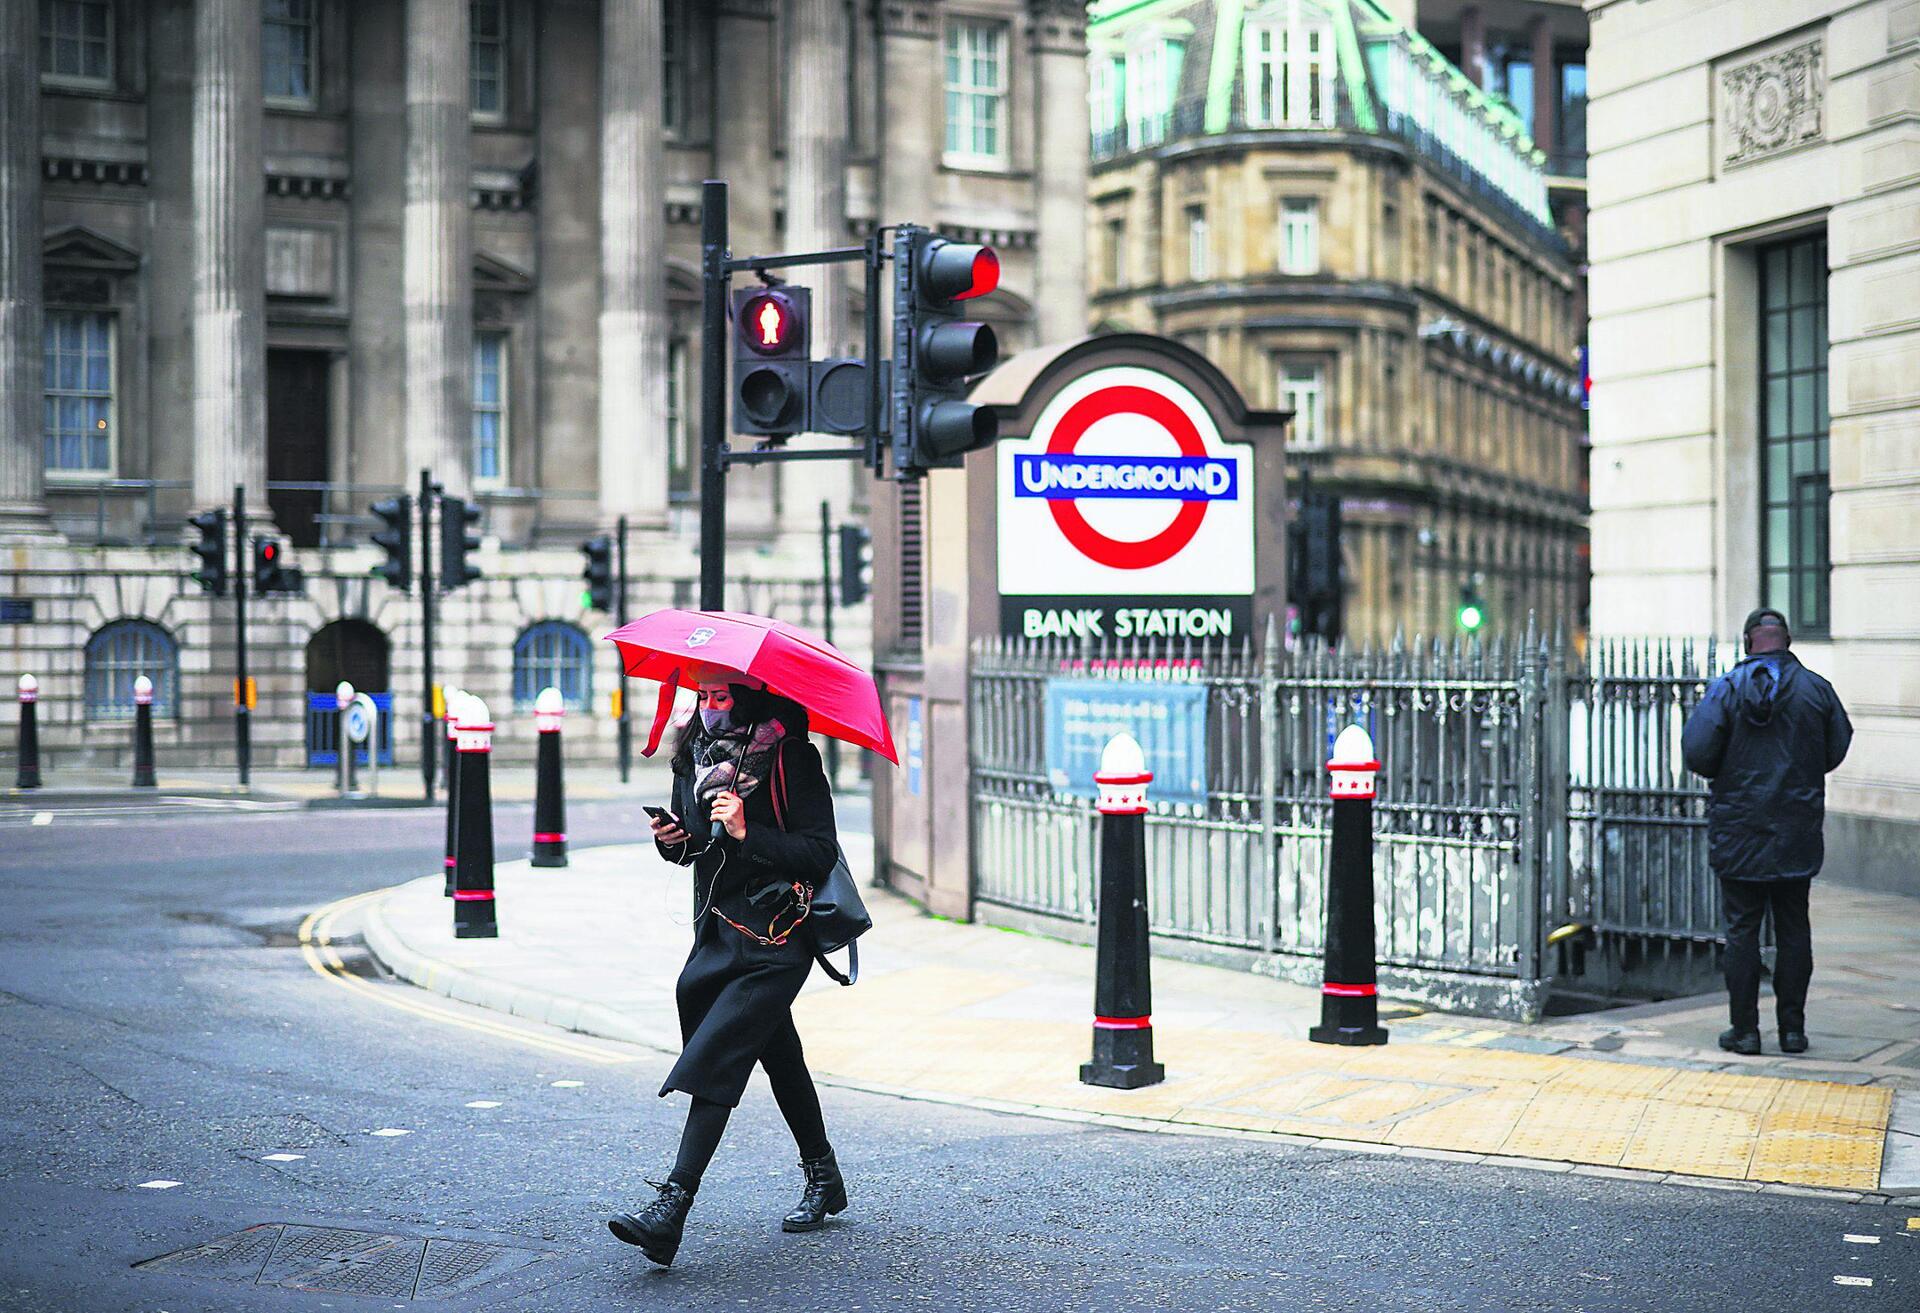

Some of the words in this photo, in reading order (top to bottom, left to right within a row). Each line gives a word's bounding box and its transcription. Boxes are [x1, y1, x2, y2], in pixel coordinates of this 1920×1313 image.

[1022, 460, 1231, 495] UNDERGROUND
[1023, 608, 1103, 638] BANK
[1115, 608, 1232, 637] STATION
